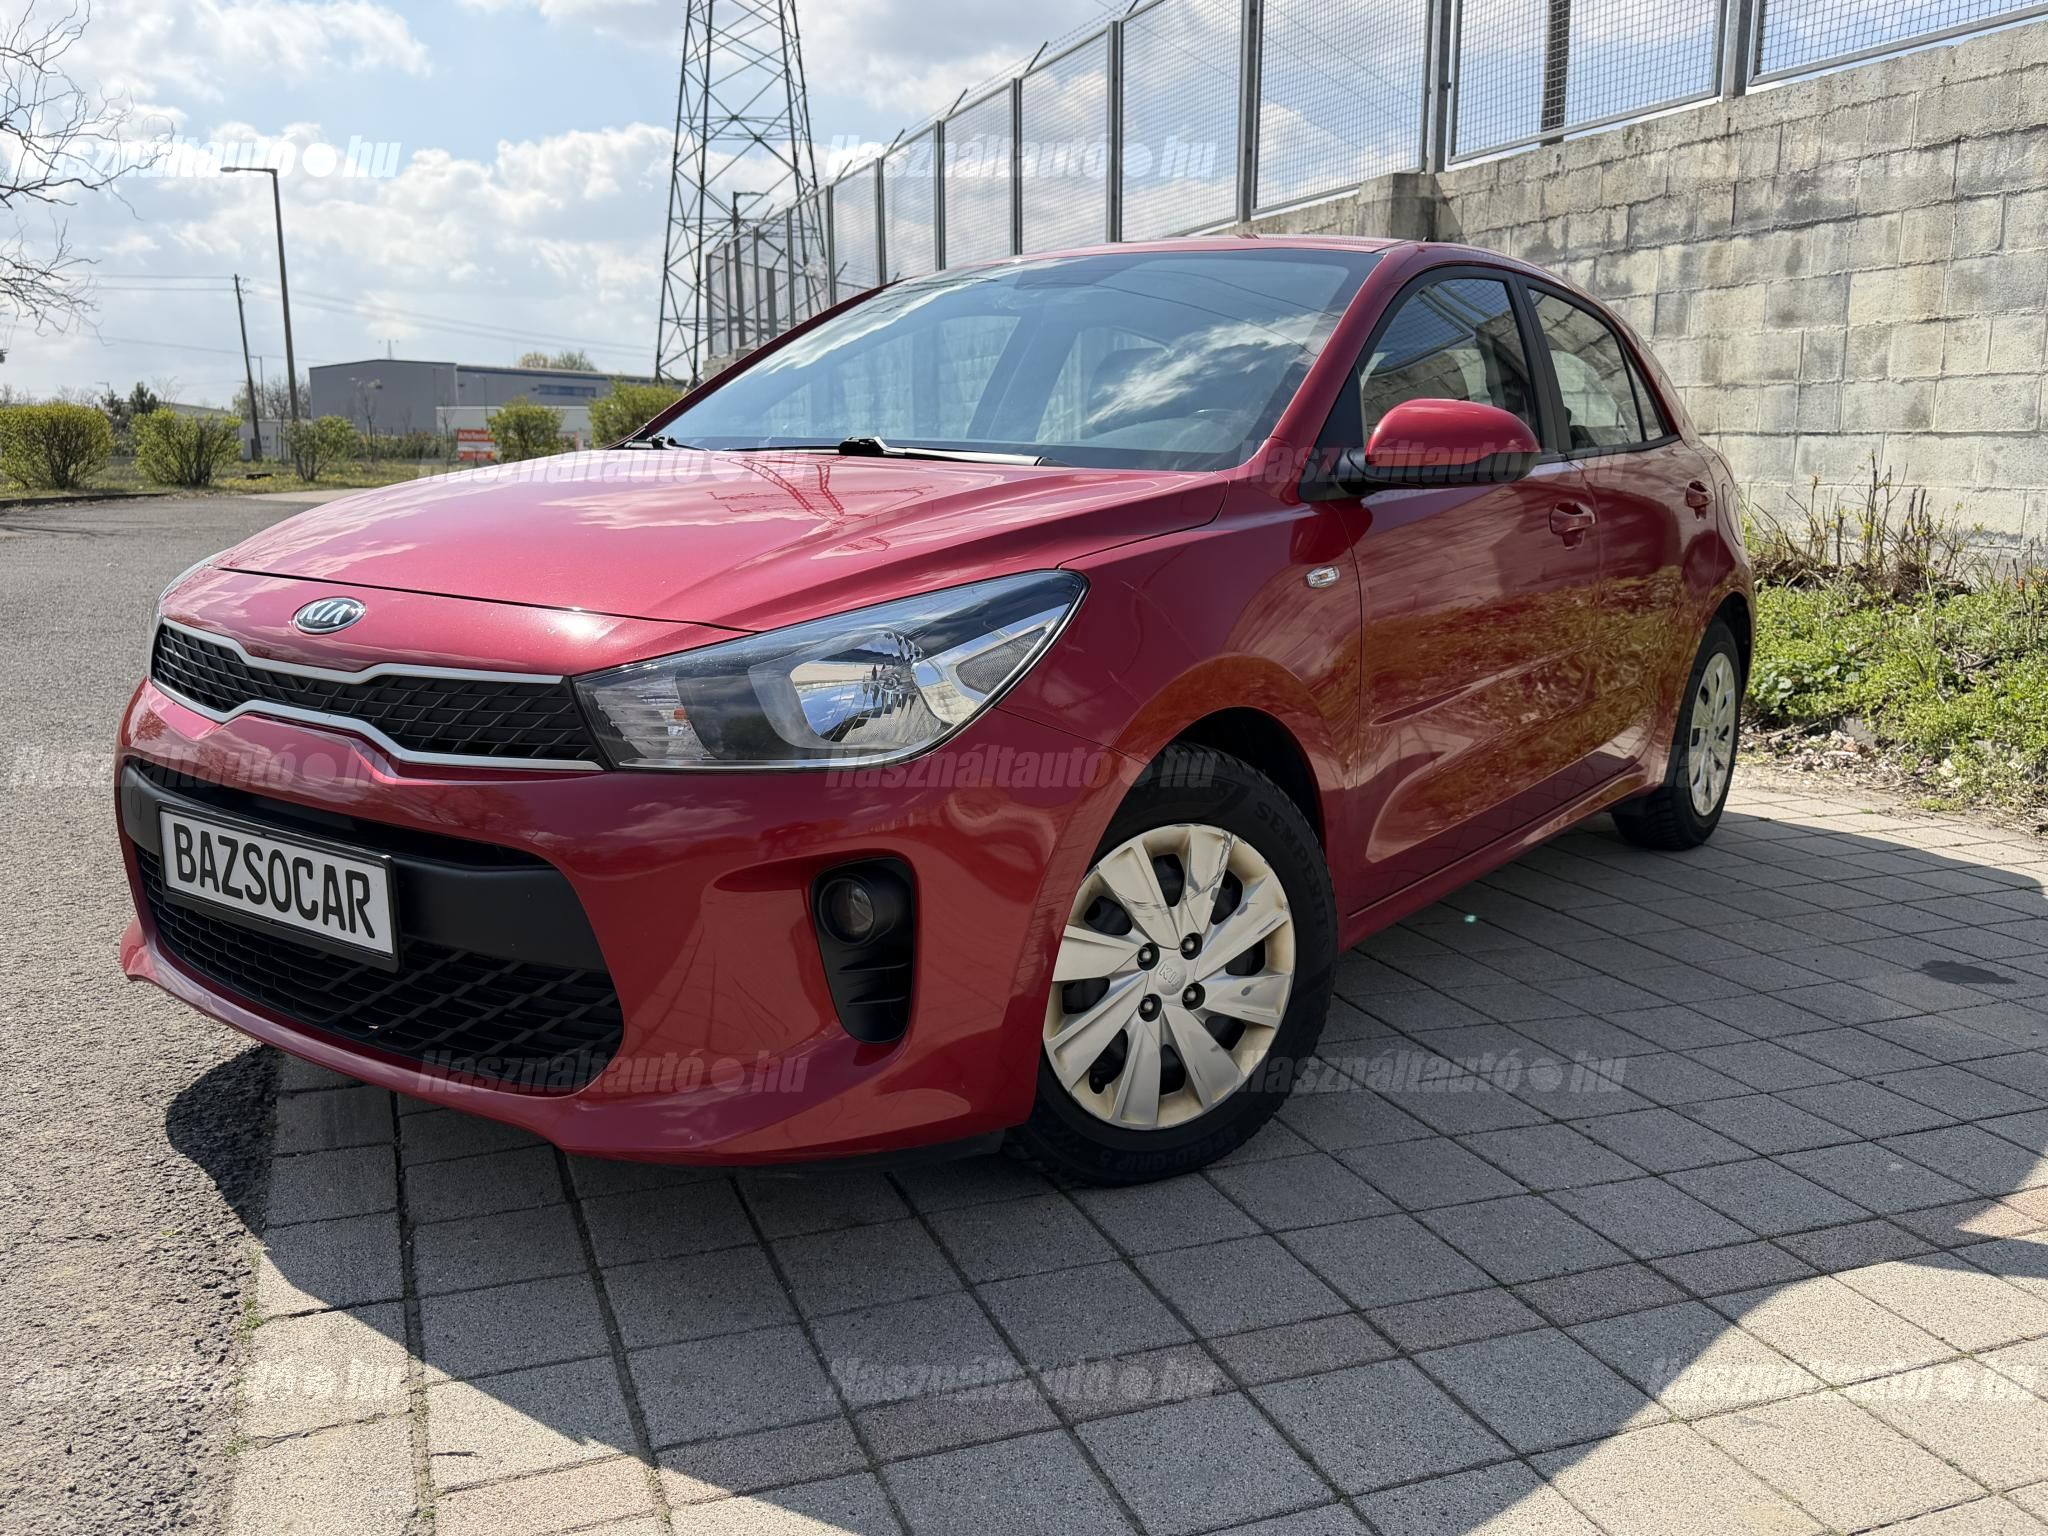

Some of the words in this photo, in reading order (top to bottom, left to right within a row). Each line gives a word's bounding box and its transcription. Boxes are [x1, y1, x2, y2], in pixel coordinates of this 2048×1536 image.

[298, 601, 351, 625] KIA
[173, 822, 375, 939] BAZSOCAR
[1254, 801, 1329, 929] SEMPERIT
